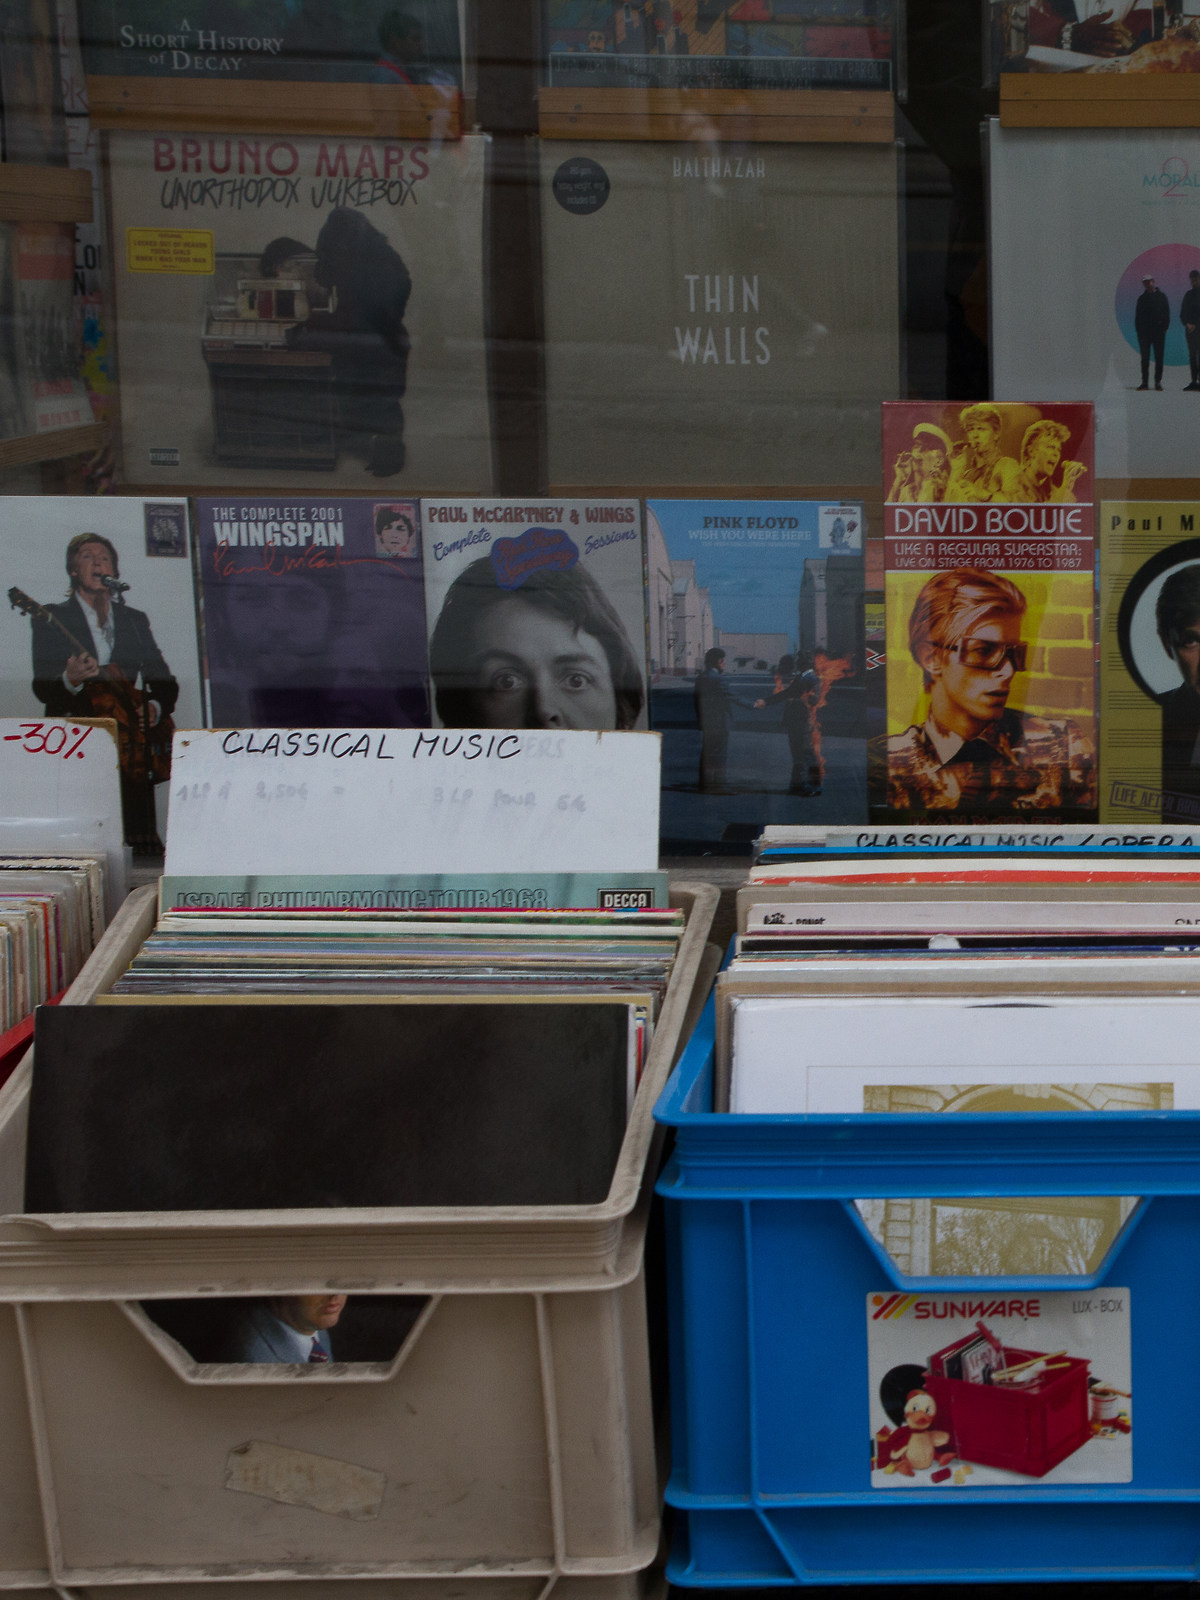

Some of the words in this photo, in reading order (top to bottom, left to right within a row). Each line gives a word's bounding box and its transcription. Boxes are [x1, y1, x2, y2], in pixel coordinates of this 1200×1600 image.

[179, 18, 192, 32] A
[153, 138, 300, 176] BRUNO
[315, 143, 431, 181] MARS
[672, 157, 767, 179] BALTHAZAR
[160, 176, 300, 210] UNORTHODOX
[311, 176, 419, 209] JUKEBOX
[683, 274, 760, 313] THIN
[674, 326, 771, 365] WALLS
[212, 507, 237, 521] THE
[240, 507, 307, 521] COMPLETE
[310, 507, 344, 521] 2001
[428, 506, 469, 523] PAUL
[472, 507, 564, 523] McCARTNEY
[569, 508, 579, 525] &
[585, 507, 636, 523] WINGS
[703, 516, 744, 529] PINK
[746, 516, 800, 529] FLOYD
[894, 508, 978, 533] DAVID
[985, 508, 1082, 533] BOWIE
[1111, 515, 1163, 531] Paul
[213, 521, 345, 547] WINGSPAN
[432, 527, 492, 561] Complete
[583, 528, 639, 555] Sessions
[687, 530, 719, 541] WISH
[720, 530, 746, 541] YOU
[747, 530, 780, 541] WERE
[780, 530, 813, 541] HERE
[894, 543, 922, 555] LIKE
[924, 543, 936, 555] A
[938, 543, 1001, 556] REGULAR
[1004, 543, 1083, 556] SUPERSTAR:
[895, 557, 917, 568] LIVE
[918, 557, 936, 568] ON
[938, 557, 973, 568] STAGE
[974, 557, 1006, 568] FROM
[1007, 557, 1035, 568] 1976
[1036, 557, 1053, 568] TO
[1055, 557, 1082, 568] 1987
[3, 723, 93, 759] -30%
[221, 731, 395, 760] CLASSICAL
[412, 732, 522, 760] MUSIC
[1113, 786, 1137, 804] LIFE
[603, 893, 647, 908] DECCA
[914, 1299, 1041, 1320] SUNWARE
